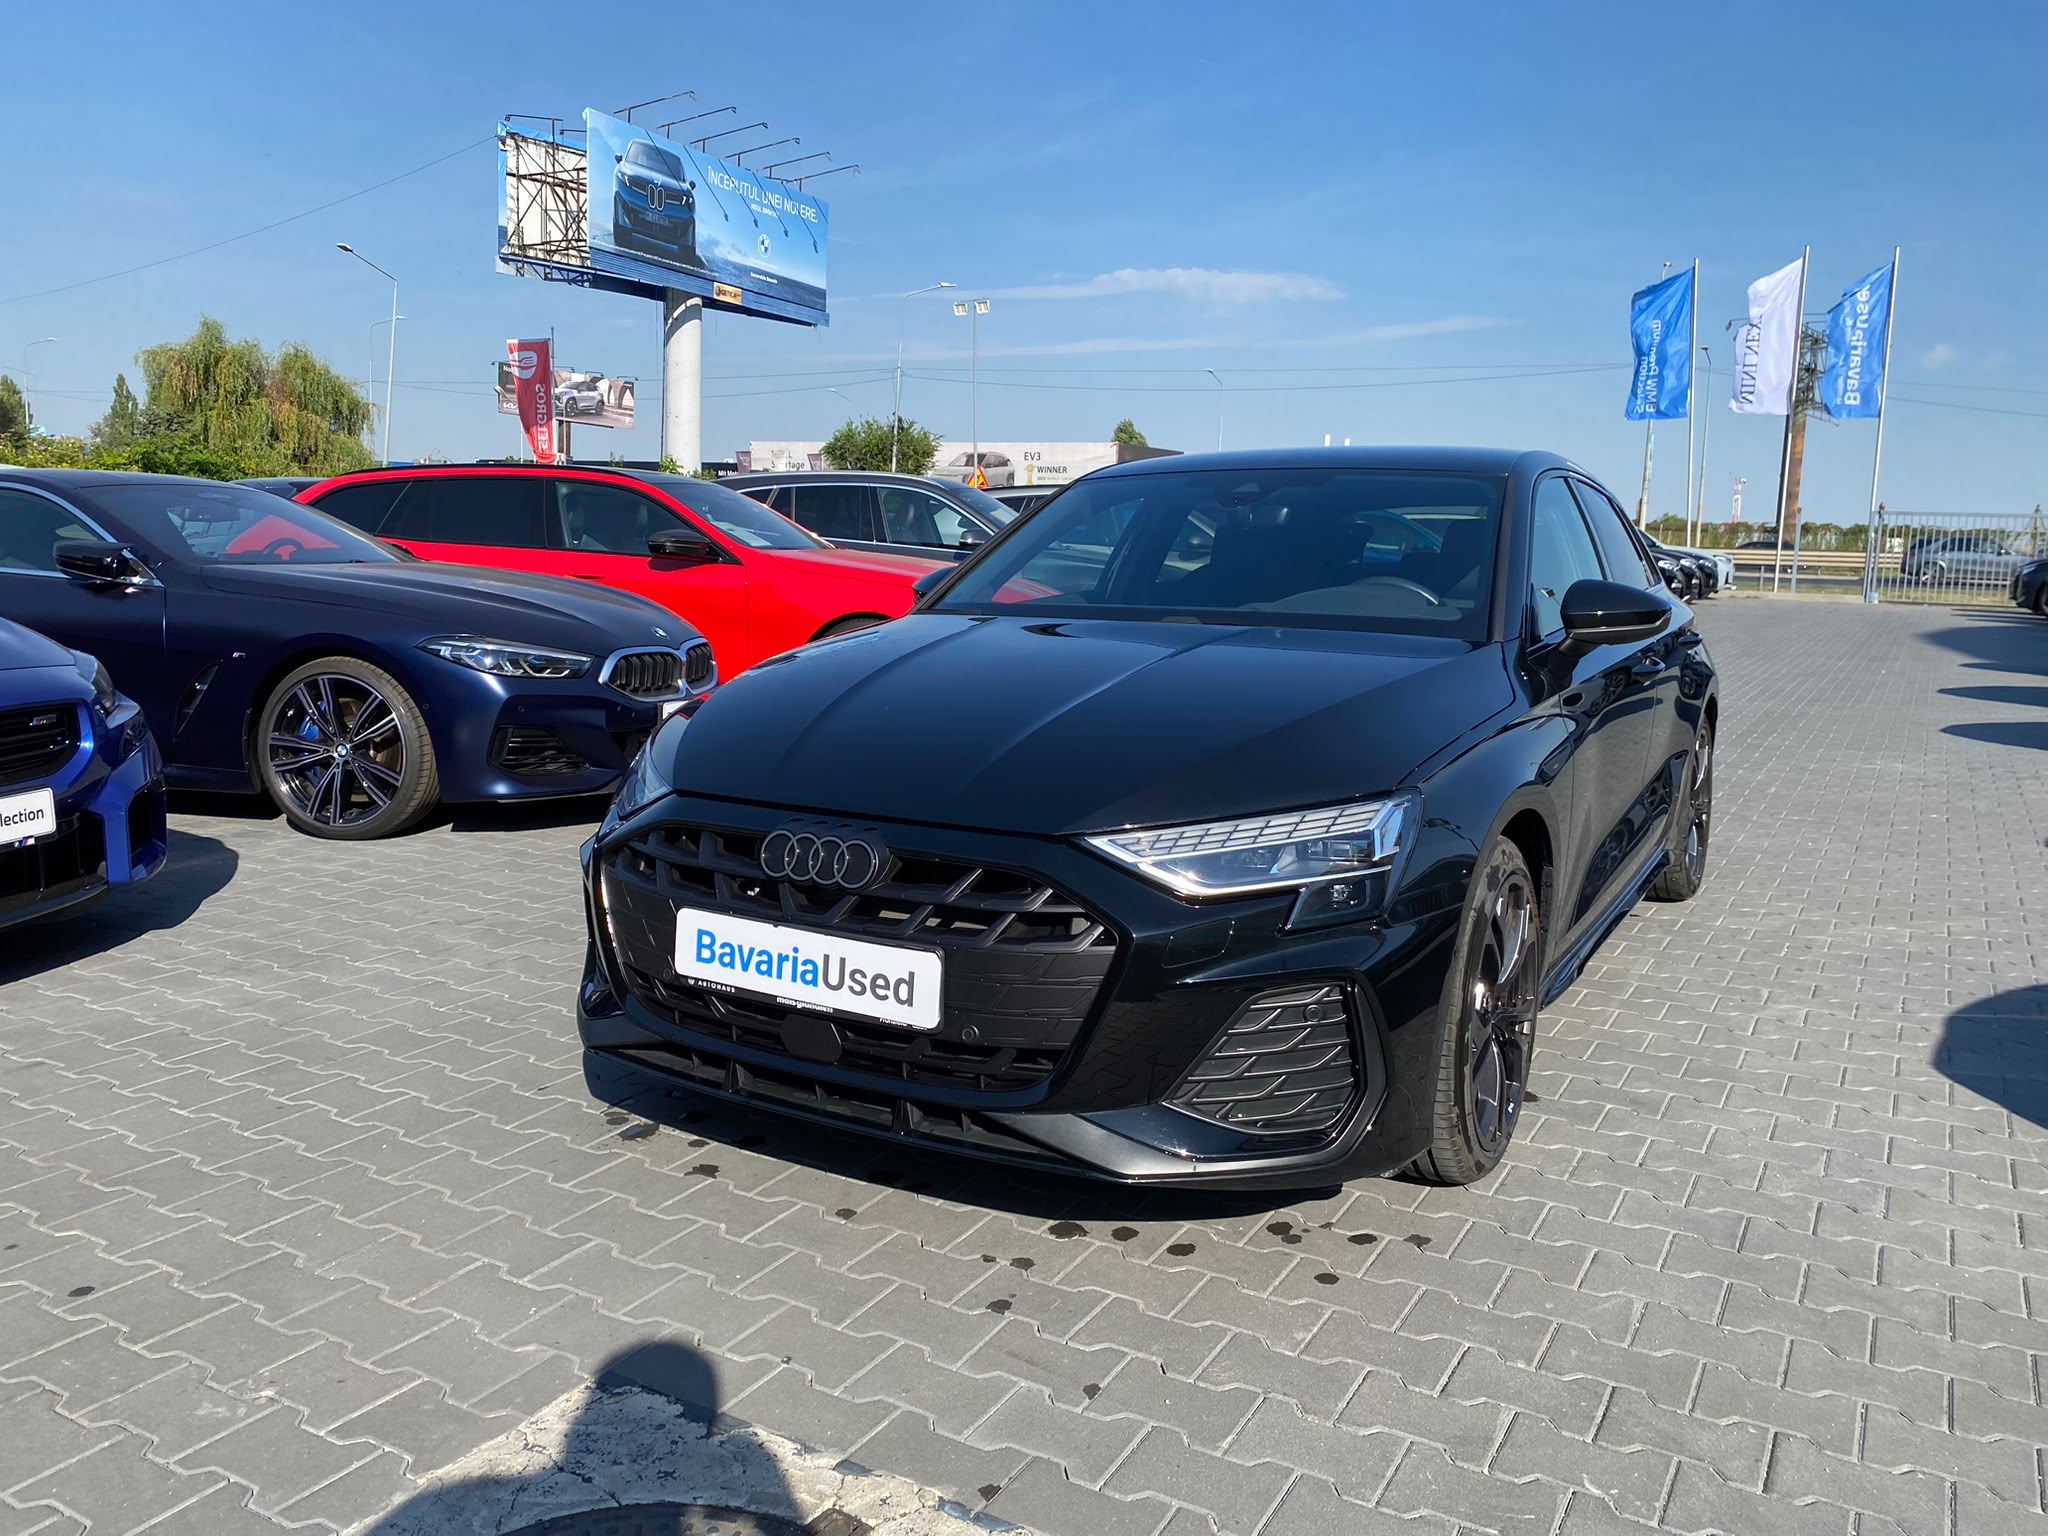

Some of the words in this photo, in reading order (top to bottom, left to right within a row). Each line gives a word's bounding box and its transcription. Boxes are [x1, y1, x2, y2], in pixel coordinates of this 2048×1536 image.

[762, 190, 783, 209] UNEI
[1024, 451, 1041, 461] EV3
[1037, 465, 1068, 474] WINNER
[0, 808, 45, 827] lection
[695, 928, 915, 1007] BavariaUsed
